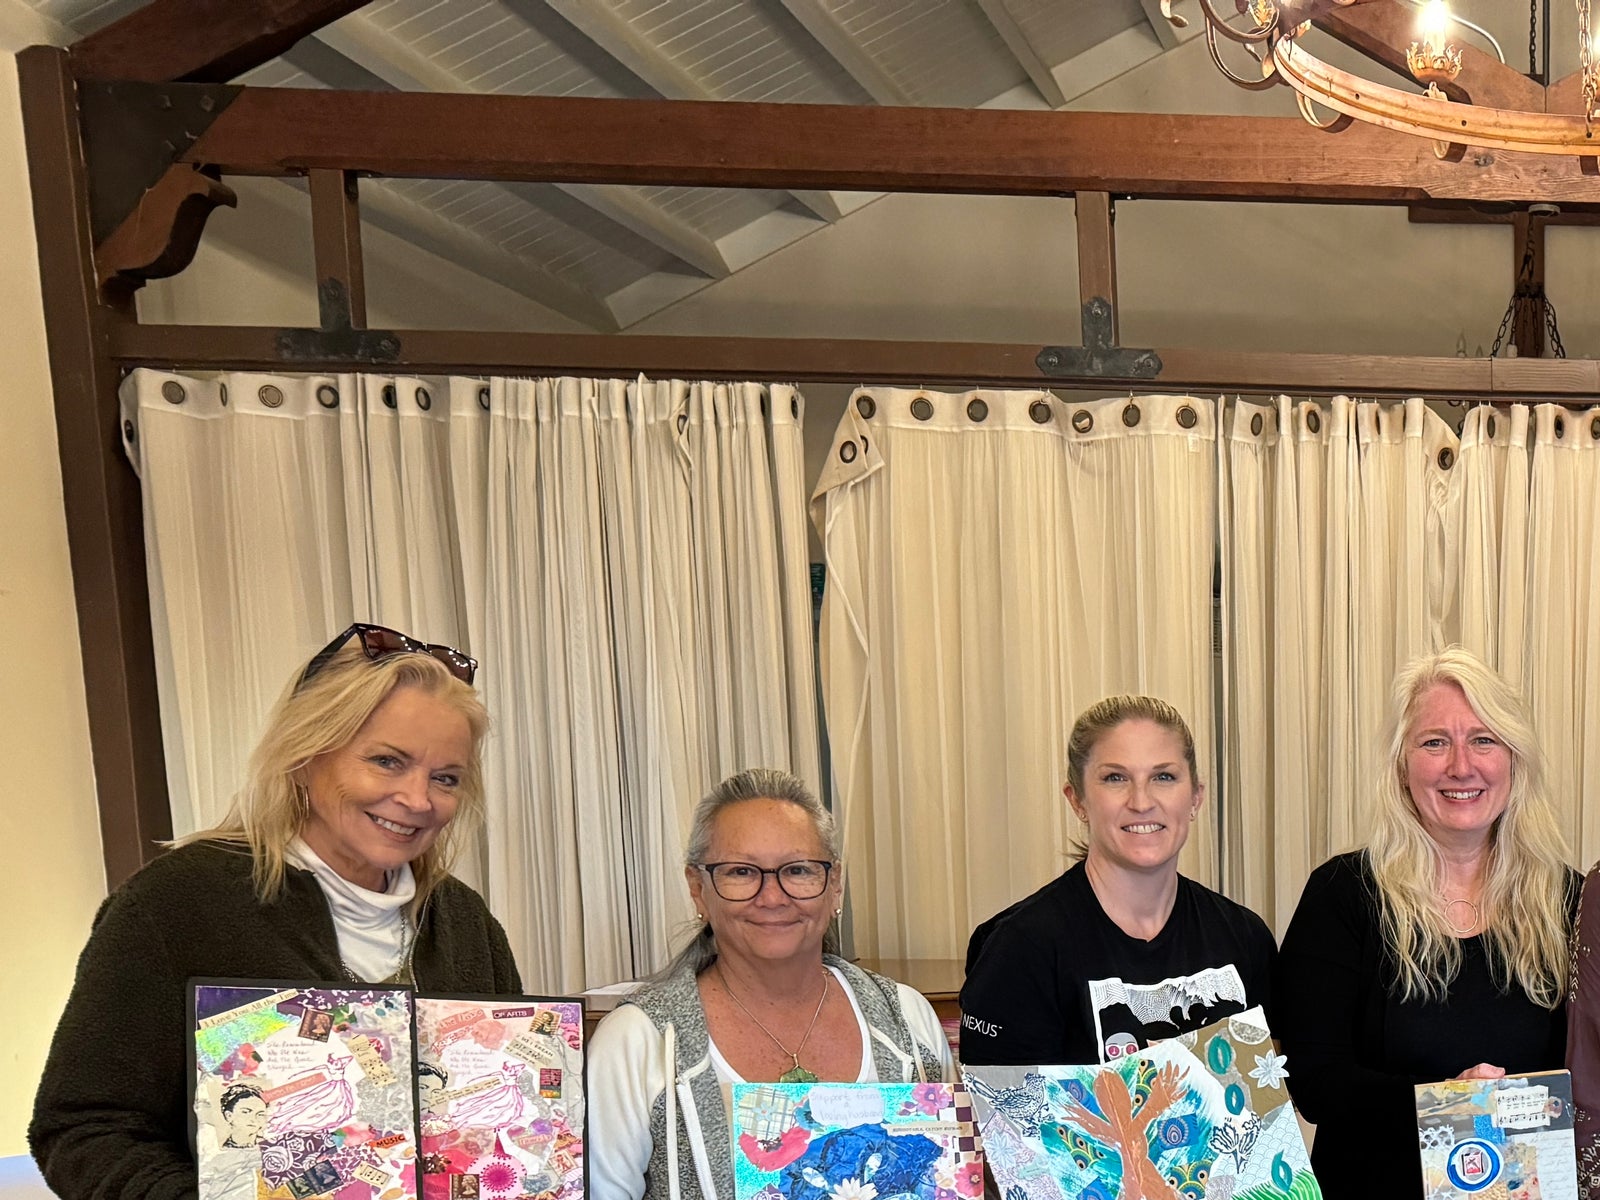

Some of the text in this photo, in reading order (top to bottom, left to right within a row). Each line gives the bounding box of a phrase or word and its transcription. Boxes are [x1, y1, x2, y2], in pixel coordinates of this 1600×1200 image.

[210, 1014, 232, 1026] Love
[232, 1008, 249, 1018] You
[251, 1002, 262, 1011] All
[264, 998, 276, 1007] the
[279, 991, 297, 1001] Time
[506, 1010, 527, 1018] ARTS
[962, 1013, 998, 1037] NEXUS
[376, 1135, 405, 1147] MUSIC
